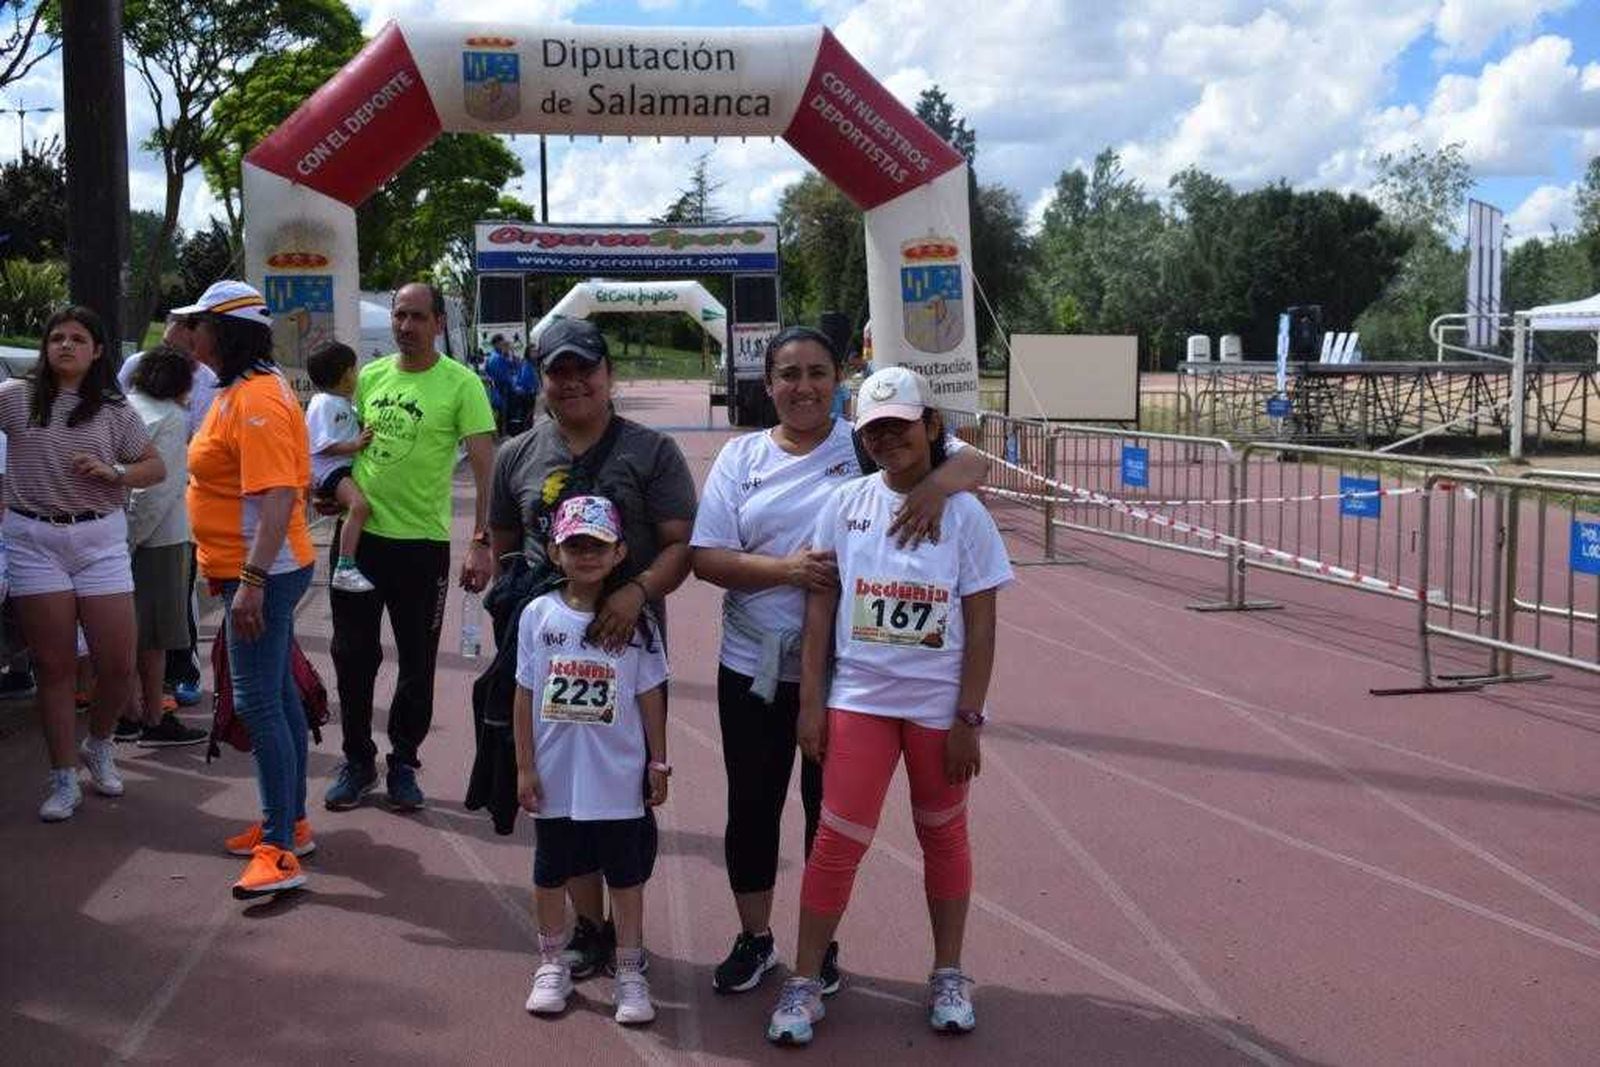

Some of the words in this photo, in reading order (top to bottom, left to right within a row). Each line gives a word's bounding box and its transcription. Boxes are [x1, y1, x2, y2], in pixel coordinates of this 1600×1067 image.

[542, 38, 736, 77] Diputación
[541, 91, 573, 115] de
[587, 83, 771, 117] Salamanca
[296, 141, 332, 176] CON
[327, 129, 350, 148] EL
[344, 70, 413, 134] DEPORTE
[809, 94, 910, 184] DEPORTISTAS
[822, 72, 855, 105] CON
[853, 100, 931, 172] NUESTROS
[517, 255, 739, 269] www.orycronsport.com
[871, 598, 932, 631] 167
[551, 677, 609, 707] 223
